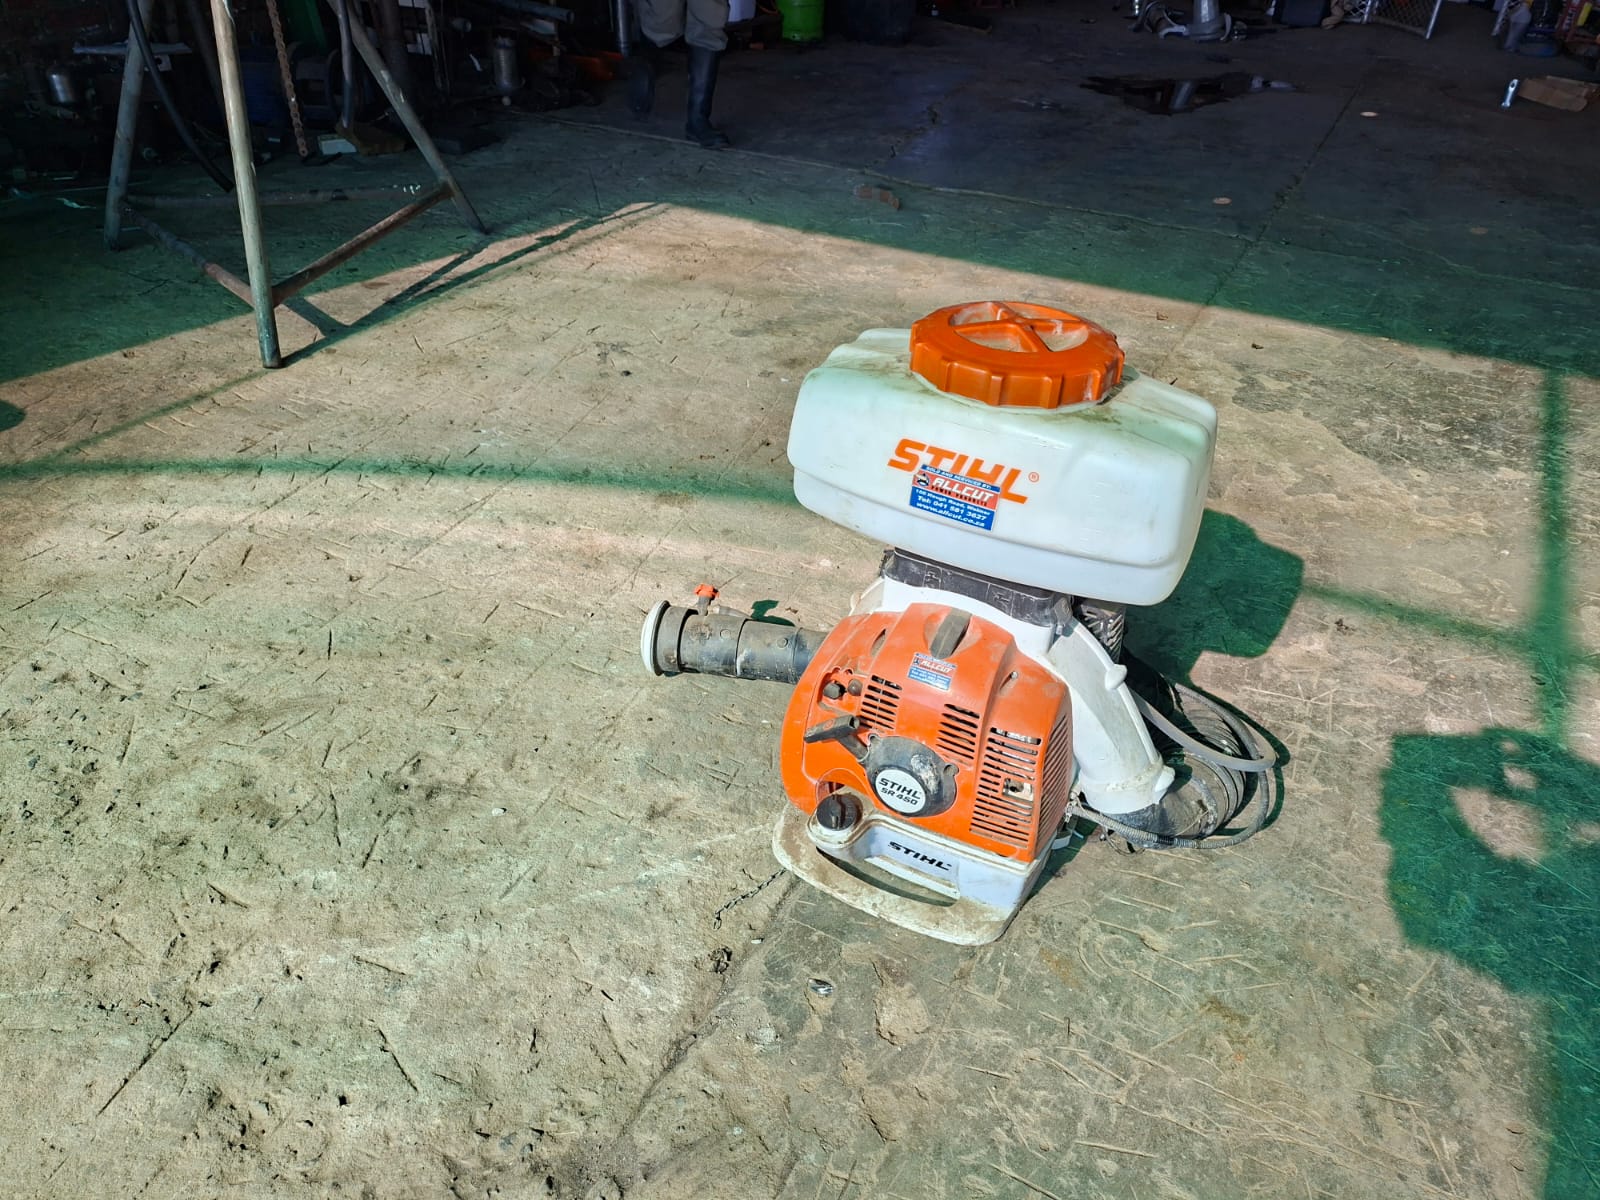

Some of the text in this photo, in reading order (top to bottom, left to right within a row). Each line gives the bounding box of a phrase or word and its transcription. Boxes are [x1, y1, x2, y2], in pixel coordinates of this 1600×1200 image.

[887, 438, 1028, 504] STIHL
[926, 466, 941, 474] SOLD
[932, 477, 994, 502] ALLCUT
[917, 495, 932, 504] Tel:
[932, 500, 948, 509] 041
[878, 777, 921, 800] STIHL
[881, 787, 918, 806] SR 450
[887, 841, 951, 871] STIHL
